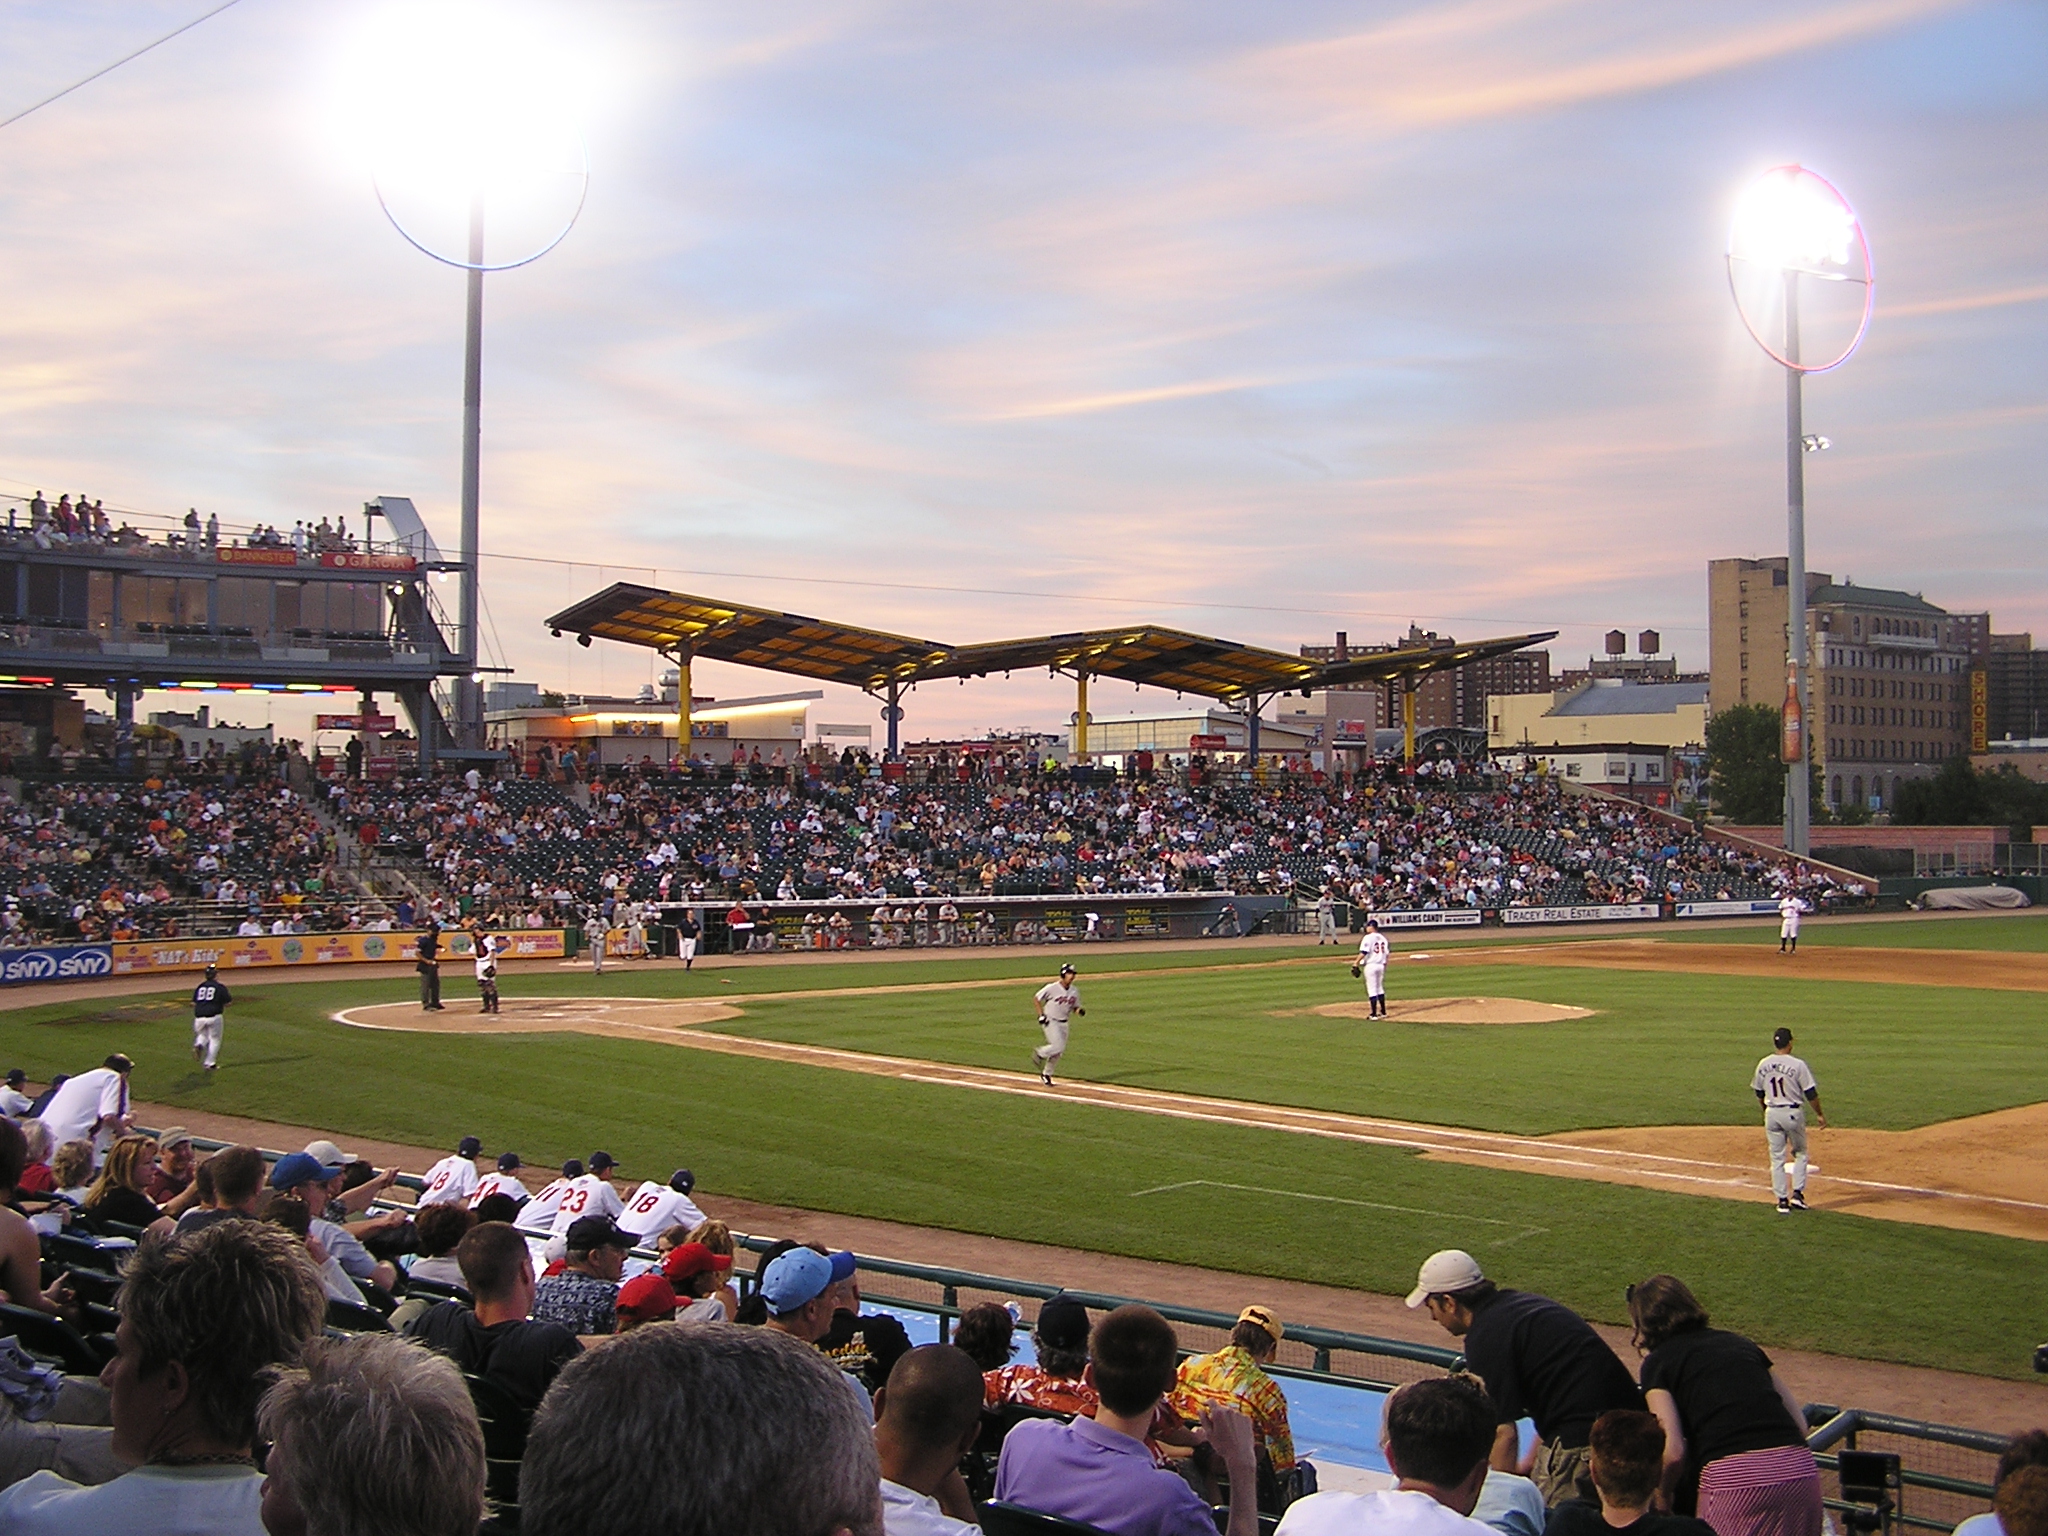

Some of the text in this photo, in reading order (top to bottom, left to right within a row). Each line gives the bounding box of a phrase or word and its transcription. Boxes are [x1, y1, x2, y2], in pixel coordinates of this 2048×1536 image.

[233, 548, 295, 563] BANNISTER
[350, 555, 406, 569] GARCIA
[1973, 672, 1985, 749] SHORE
[1391, 913, 1443, 924] WILLIAMS CANDY
[1507, 910, 1541, 921] TRACEY
[1543, 908, 1568, 920] REAL
[1570, 907, 1601, 919] ESTATE
[5, 960, 48, 979] SNY
[58, 957, 104, 976] SNY
[196, 986, 216, 1001] 88
[1769, 1076, 1786, 1098] 11
[559, 1187, 588, 1213] 23
[629, 1191, 660, 1214] 18
